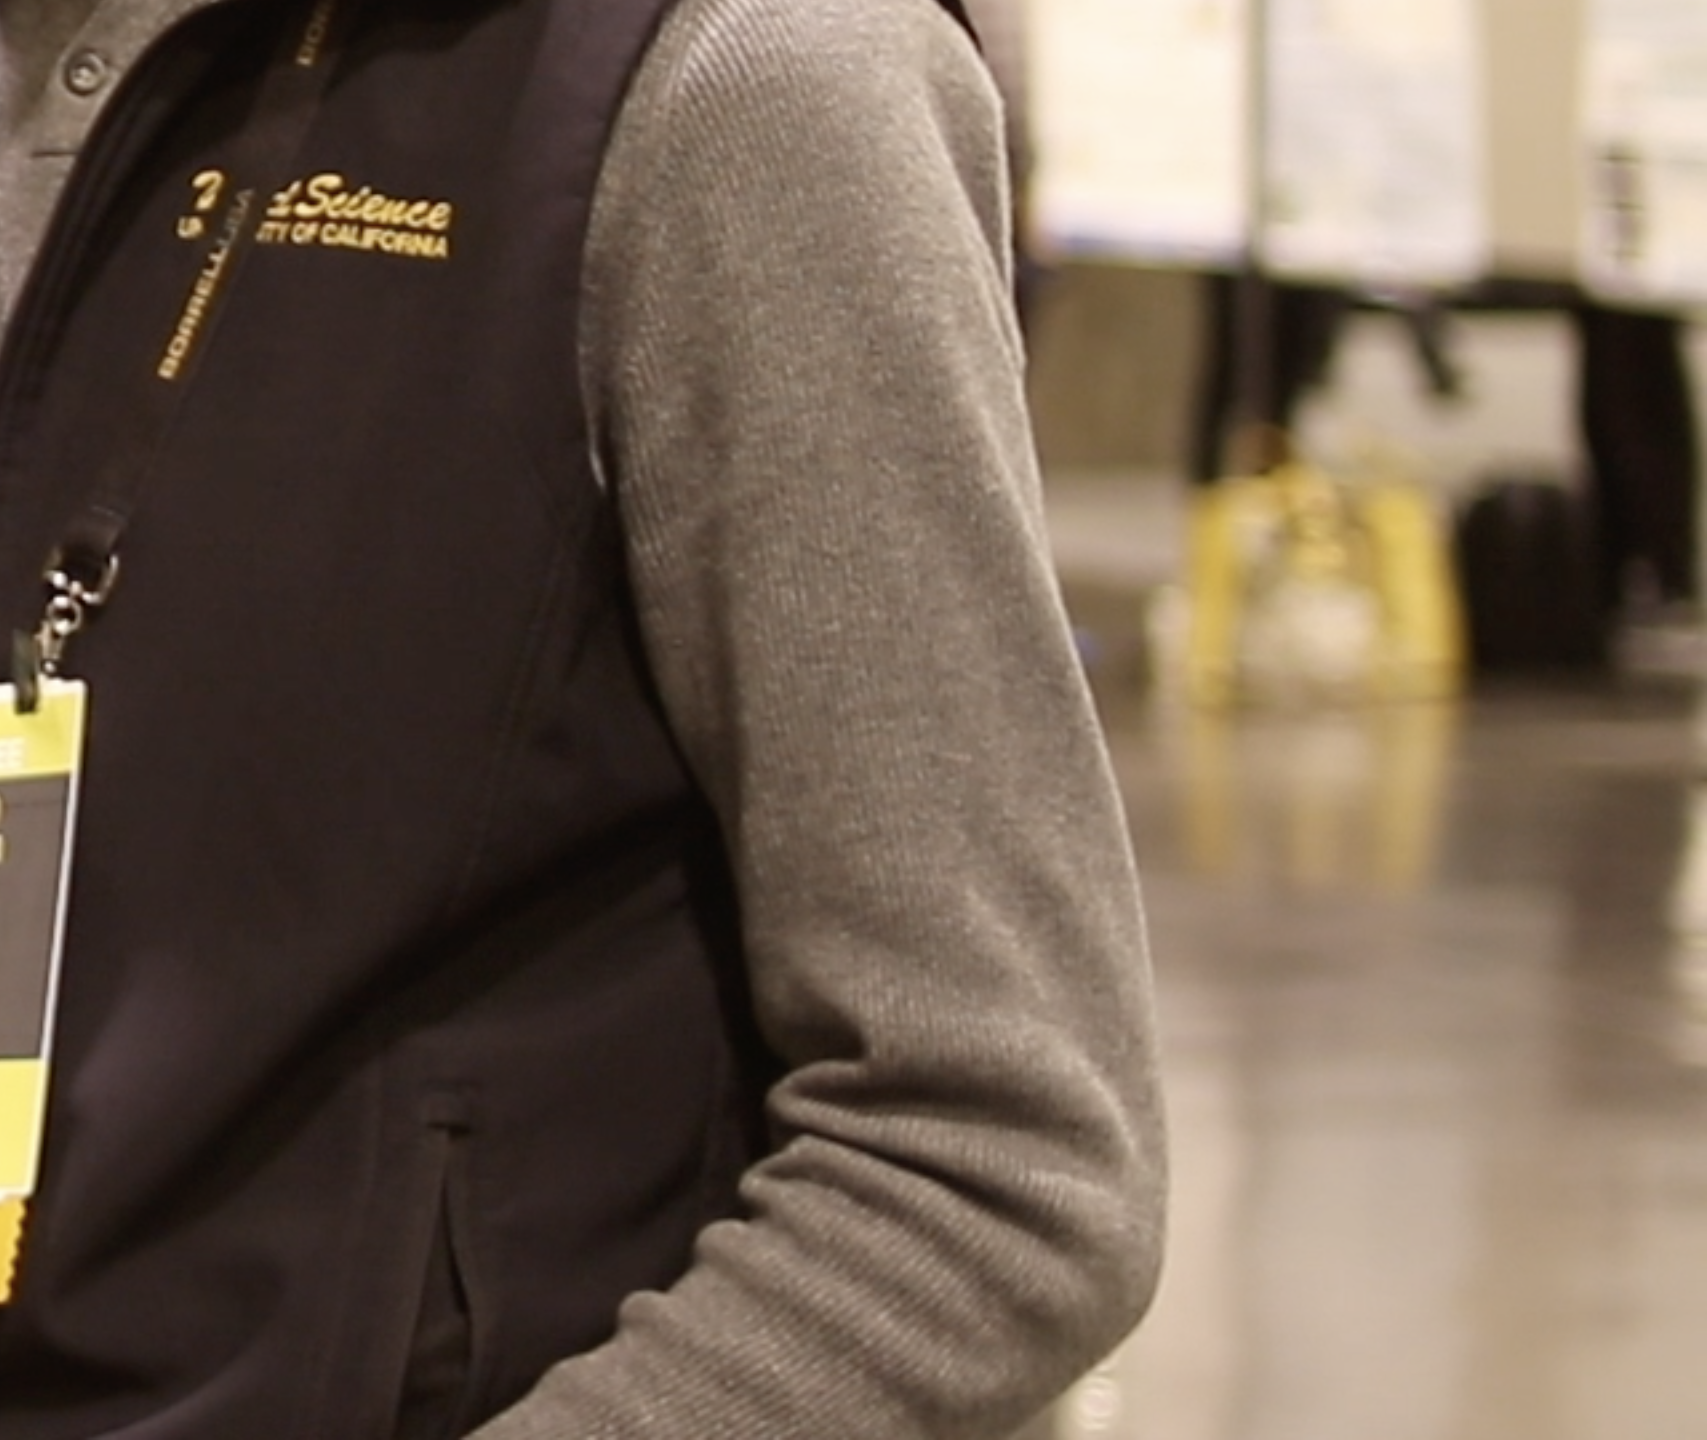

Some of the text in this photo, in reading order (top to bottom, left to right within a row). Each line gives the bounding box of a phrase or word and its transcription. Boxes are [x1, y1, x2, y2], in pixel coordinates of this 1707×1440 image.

[294, 173, 452, 228] Science
[291, 221, 319, 244] OF
[320, 224, 448, 259] CALIFORNIA
